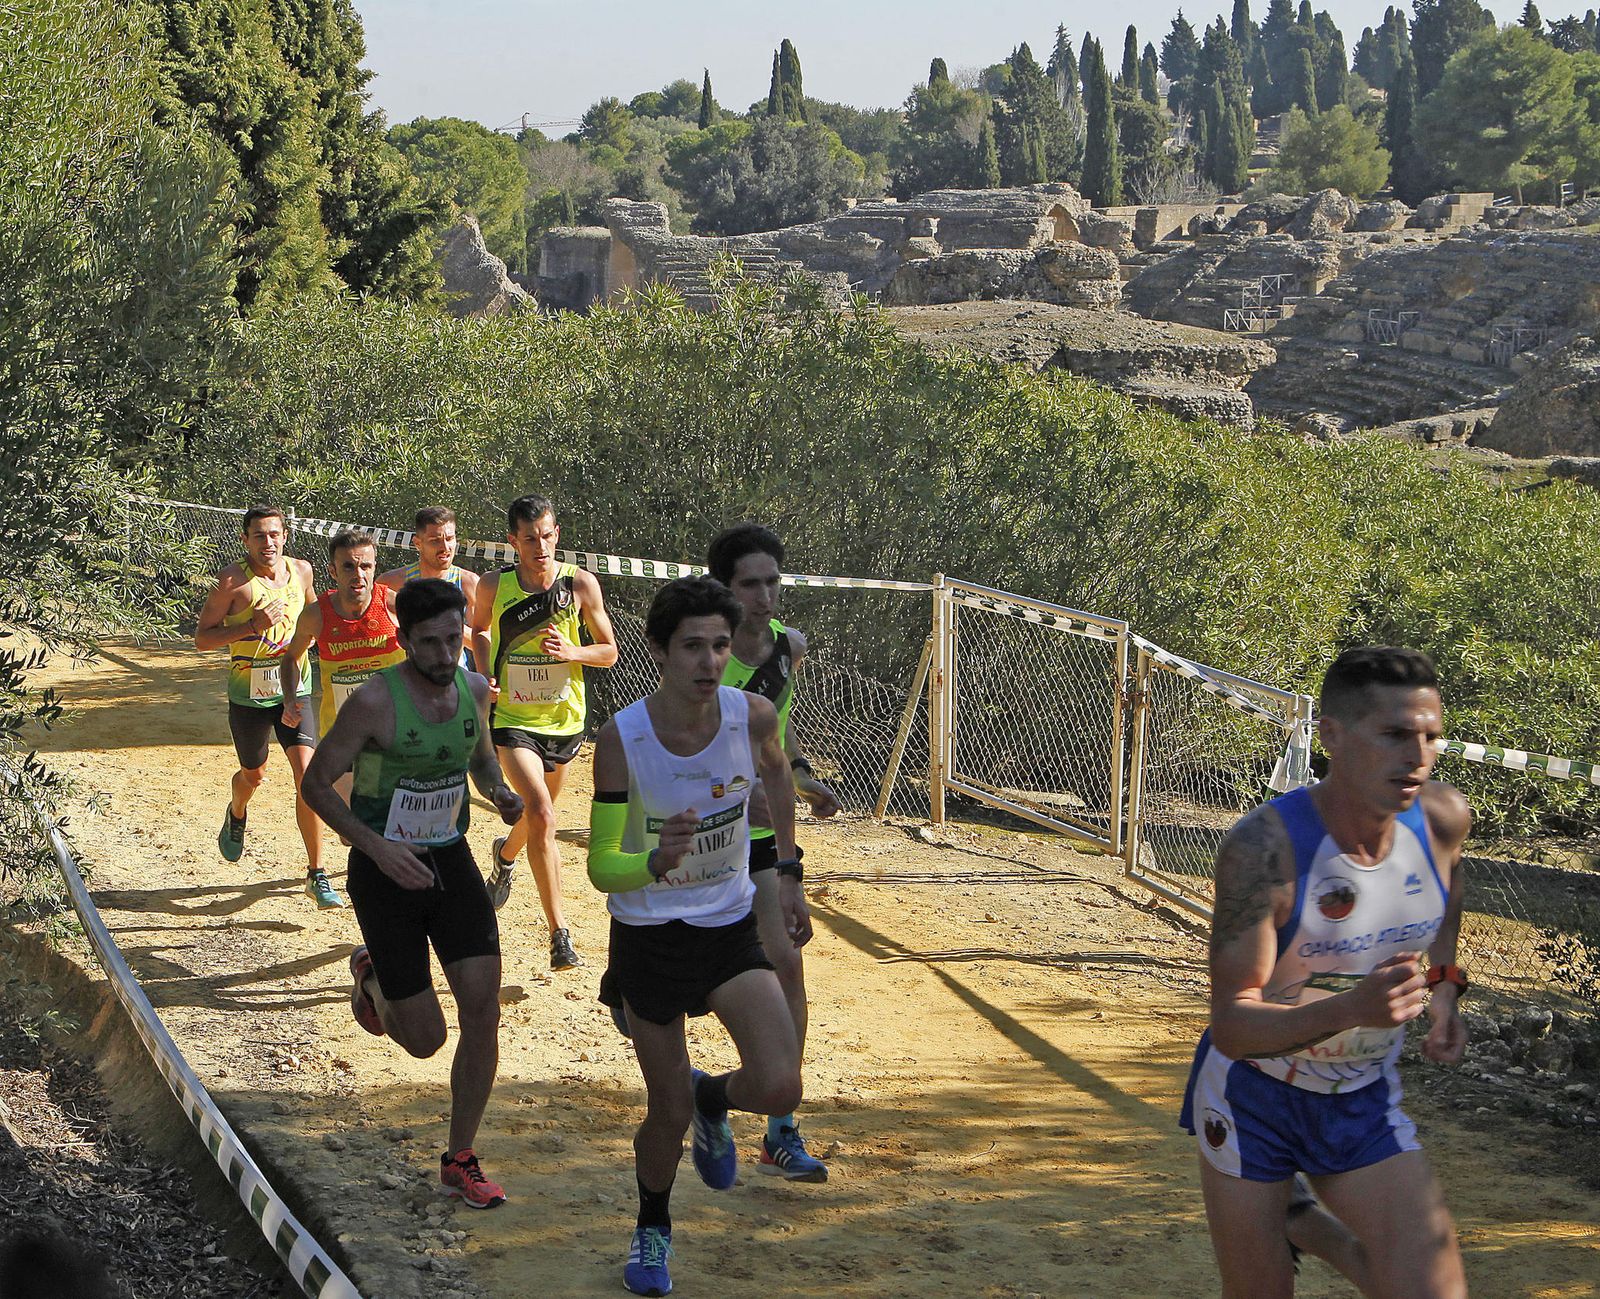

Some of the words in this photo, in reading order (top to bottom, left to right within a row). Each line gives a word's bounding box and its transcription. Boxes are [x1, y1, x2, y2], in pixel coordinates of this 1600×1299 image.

[328, 634, 388, 656] DEPORTEMANIA
[350, 663, 370, 671] PACO
[527, 668, 549, 682] VEGA
[400, 794, 426, 812] PEON
[703, 818, 714, 828] DE
[690, 826, 736, 856] ANDEZ
